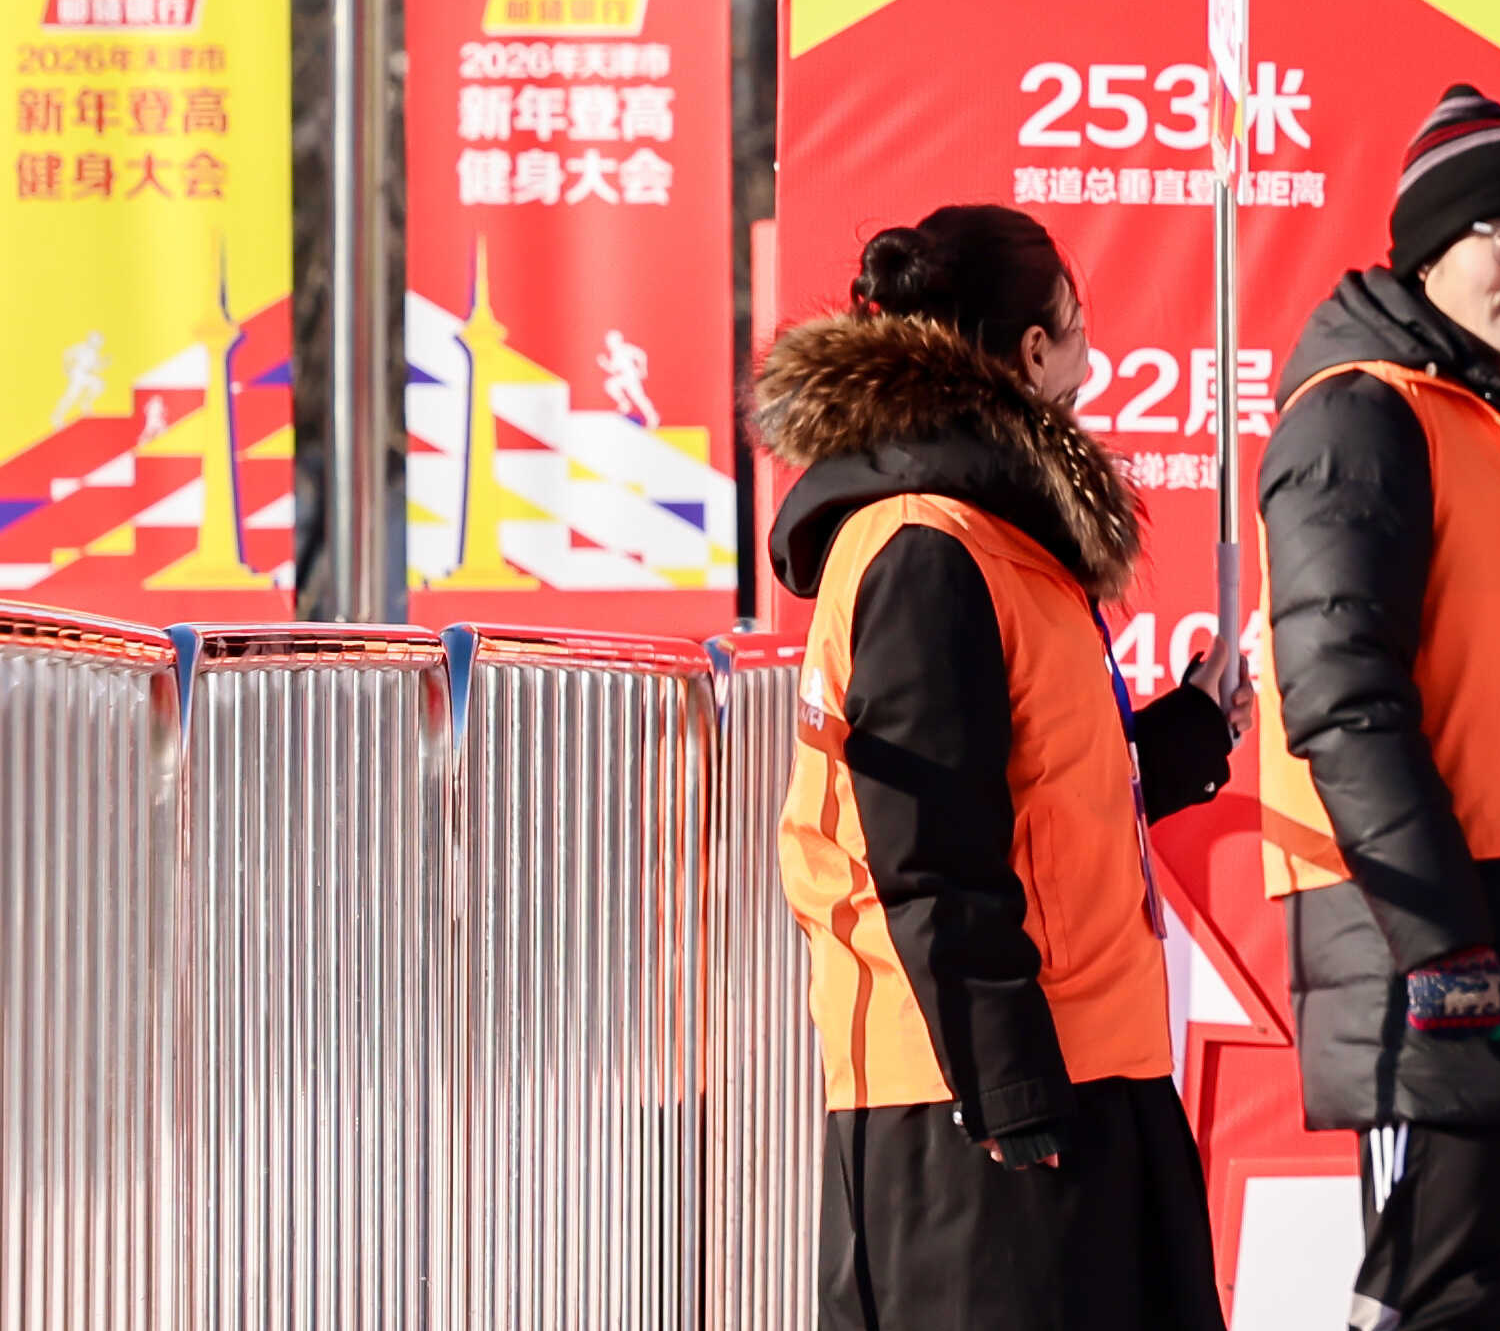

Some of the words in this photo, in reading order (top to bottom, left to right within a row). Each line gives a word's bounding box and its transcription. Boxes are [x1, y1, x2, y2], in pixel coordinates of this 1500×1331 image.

[17, 44, 228, 77] 2026年天津市
[458, 43, 672, 81] 2026年天津市
[15, 88, 231, 137] 新年登高
[457, 85, 675, 143] 新年登高
[15, 153, 230, 201] 健身大会
[457, 150, 675, 207] 健身大会
